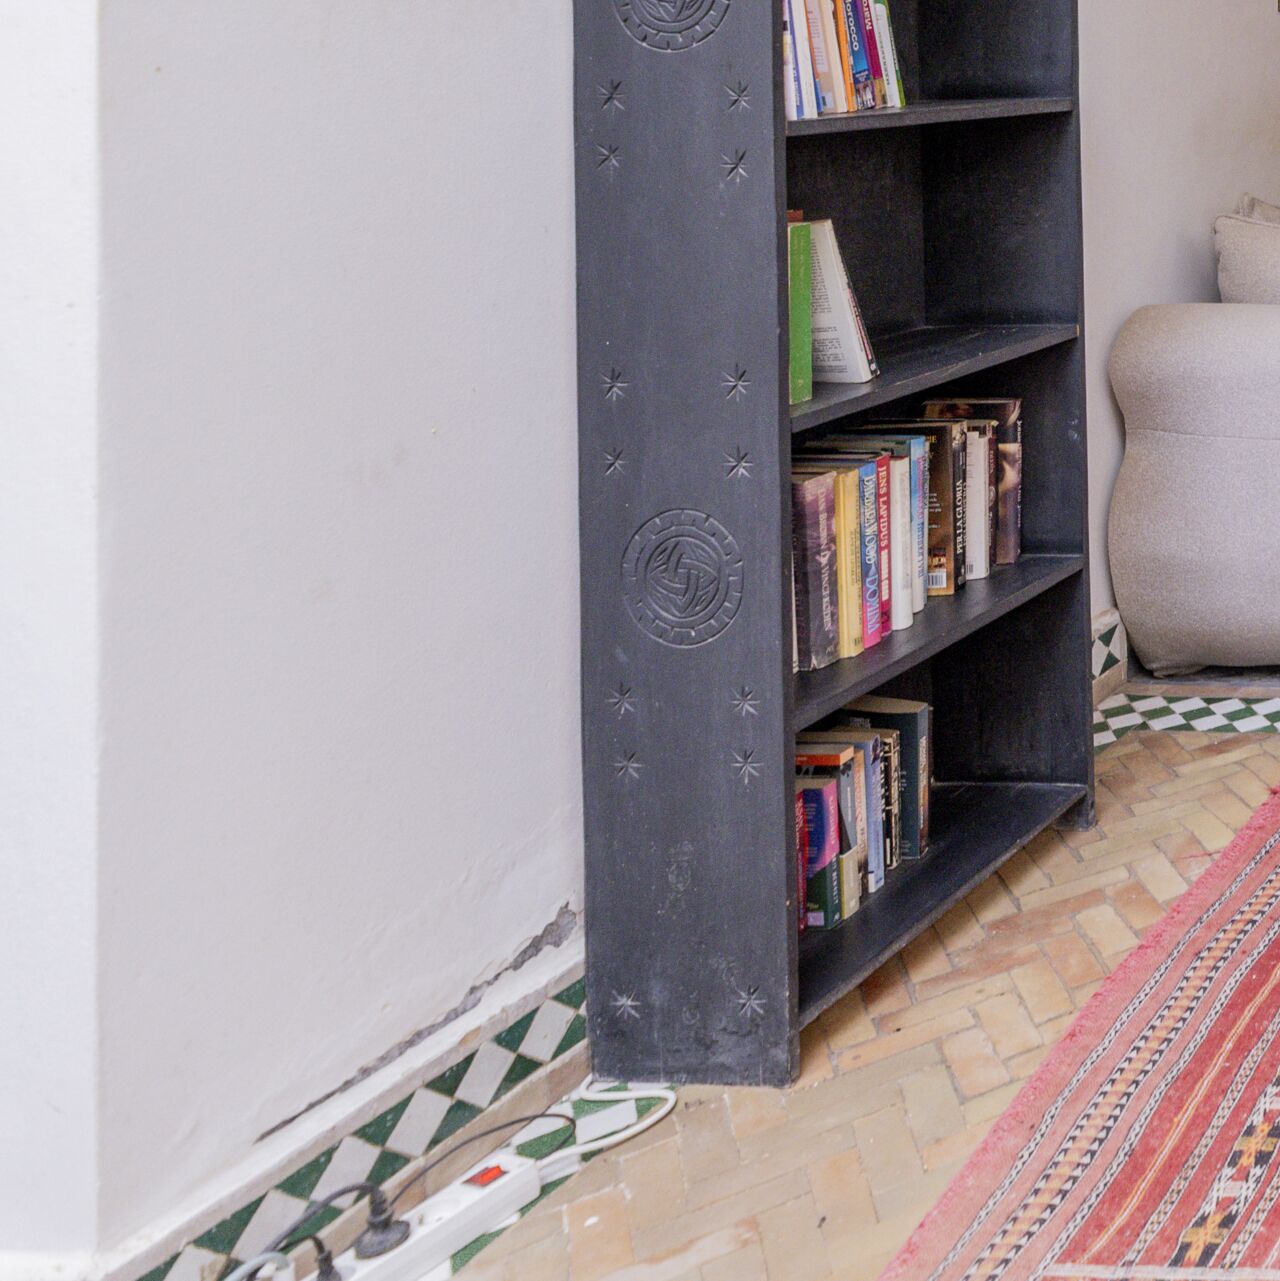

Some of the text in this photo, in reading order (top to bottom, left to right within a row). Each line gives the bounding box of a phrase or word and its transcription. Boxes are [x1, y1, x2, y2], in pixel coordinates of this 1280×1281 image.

[878, 466, 887, 495] JENS
[955, 480, 963, 519] GLORIA
[864, 523, 878, 564] WOOD
[880, 496, 889, 551] LAPIDUS
[956, 519, 962, 535] LA
[866, 575, 880, 635] DOMINA
